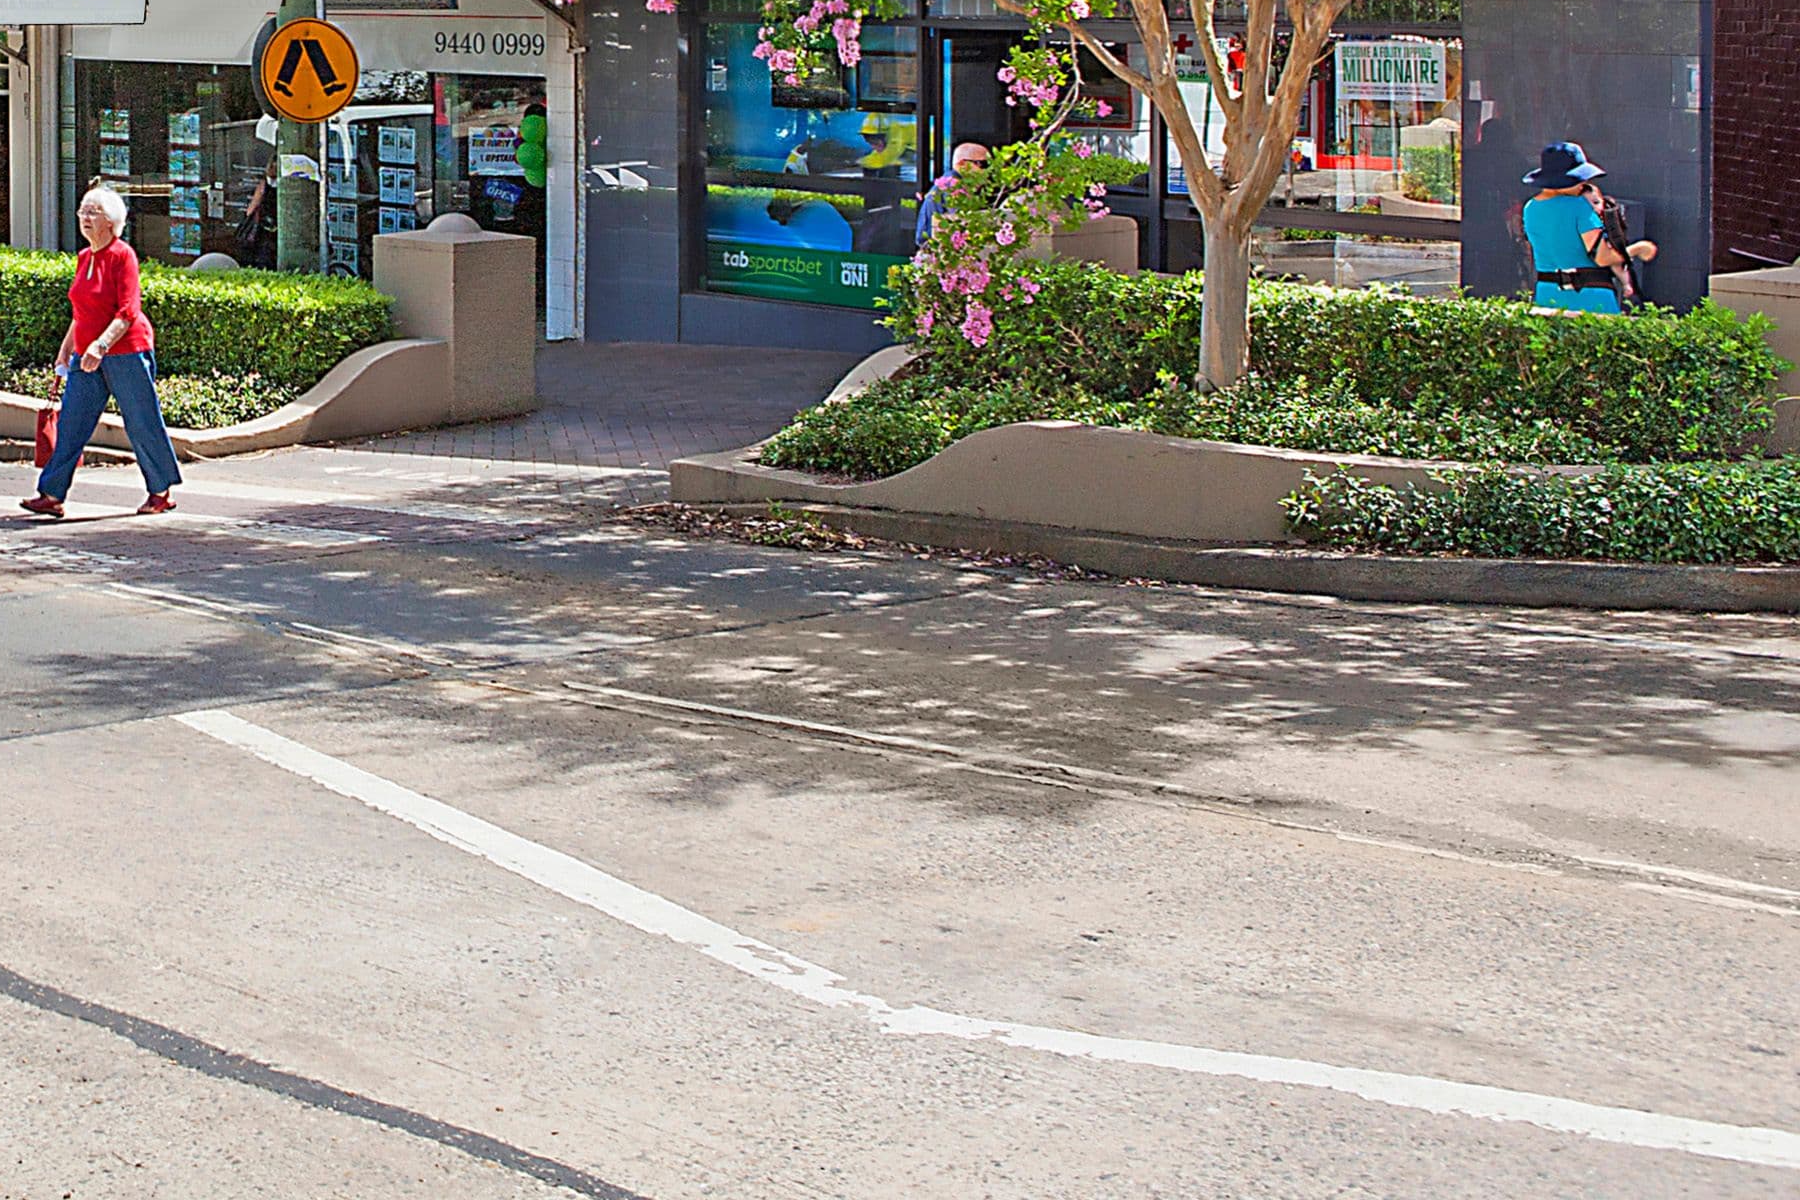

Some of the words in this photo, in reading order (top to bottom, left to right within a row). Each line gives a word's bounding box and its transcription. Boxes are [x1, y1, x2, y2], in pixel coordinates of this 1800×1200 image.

[434, 31, 485, 55] 9440
[492, 32, 545, 56] 0999
[1373, 46, 1379, 58] A
[1342, 59, 1439, 84] MILLIONAIRE
[723, 250, 823, 275] tabsportsbet
[841, 270, 869, 287] ON!
